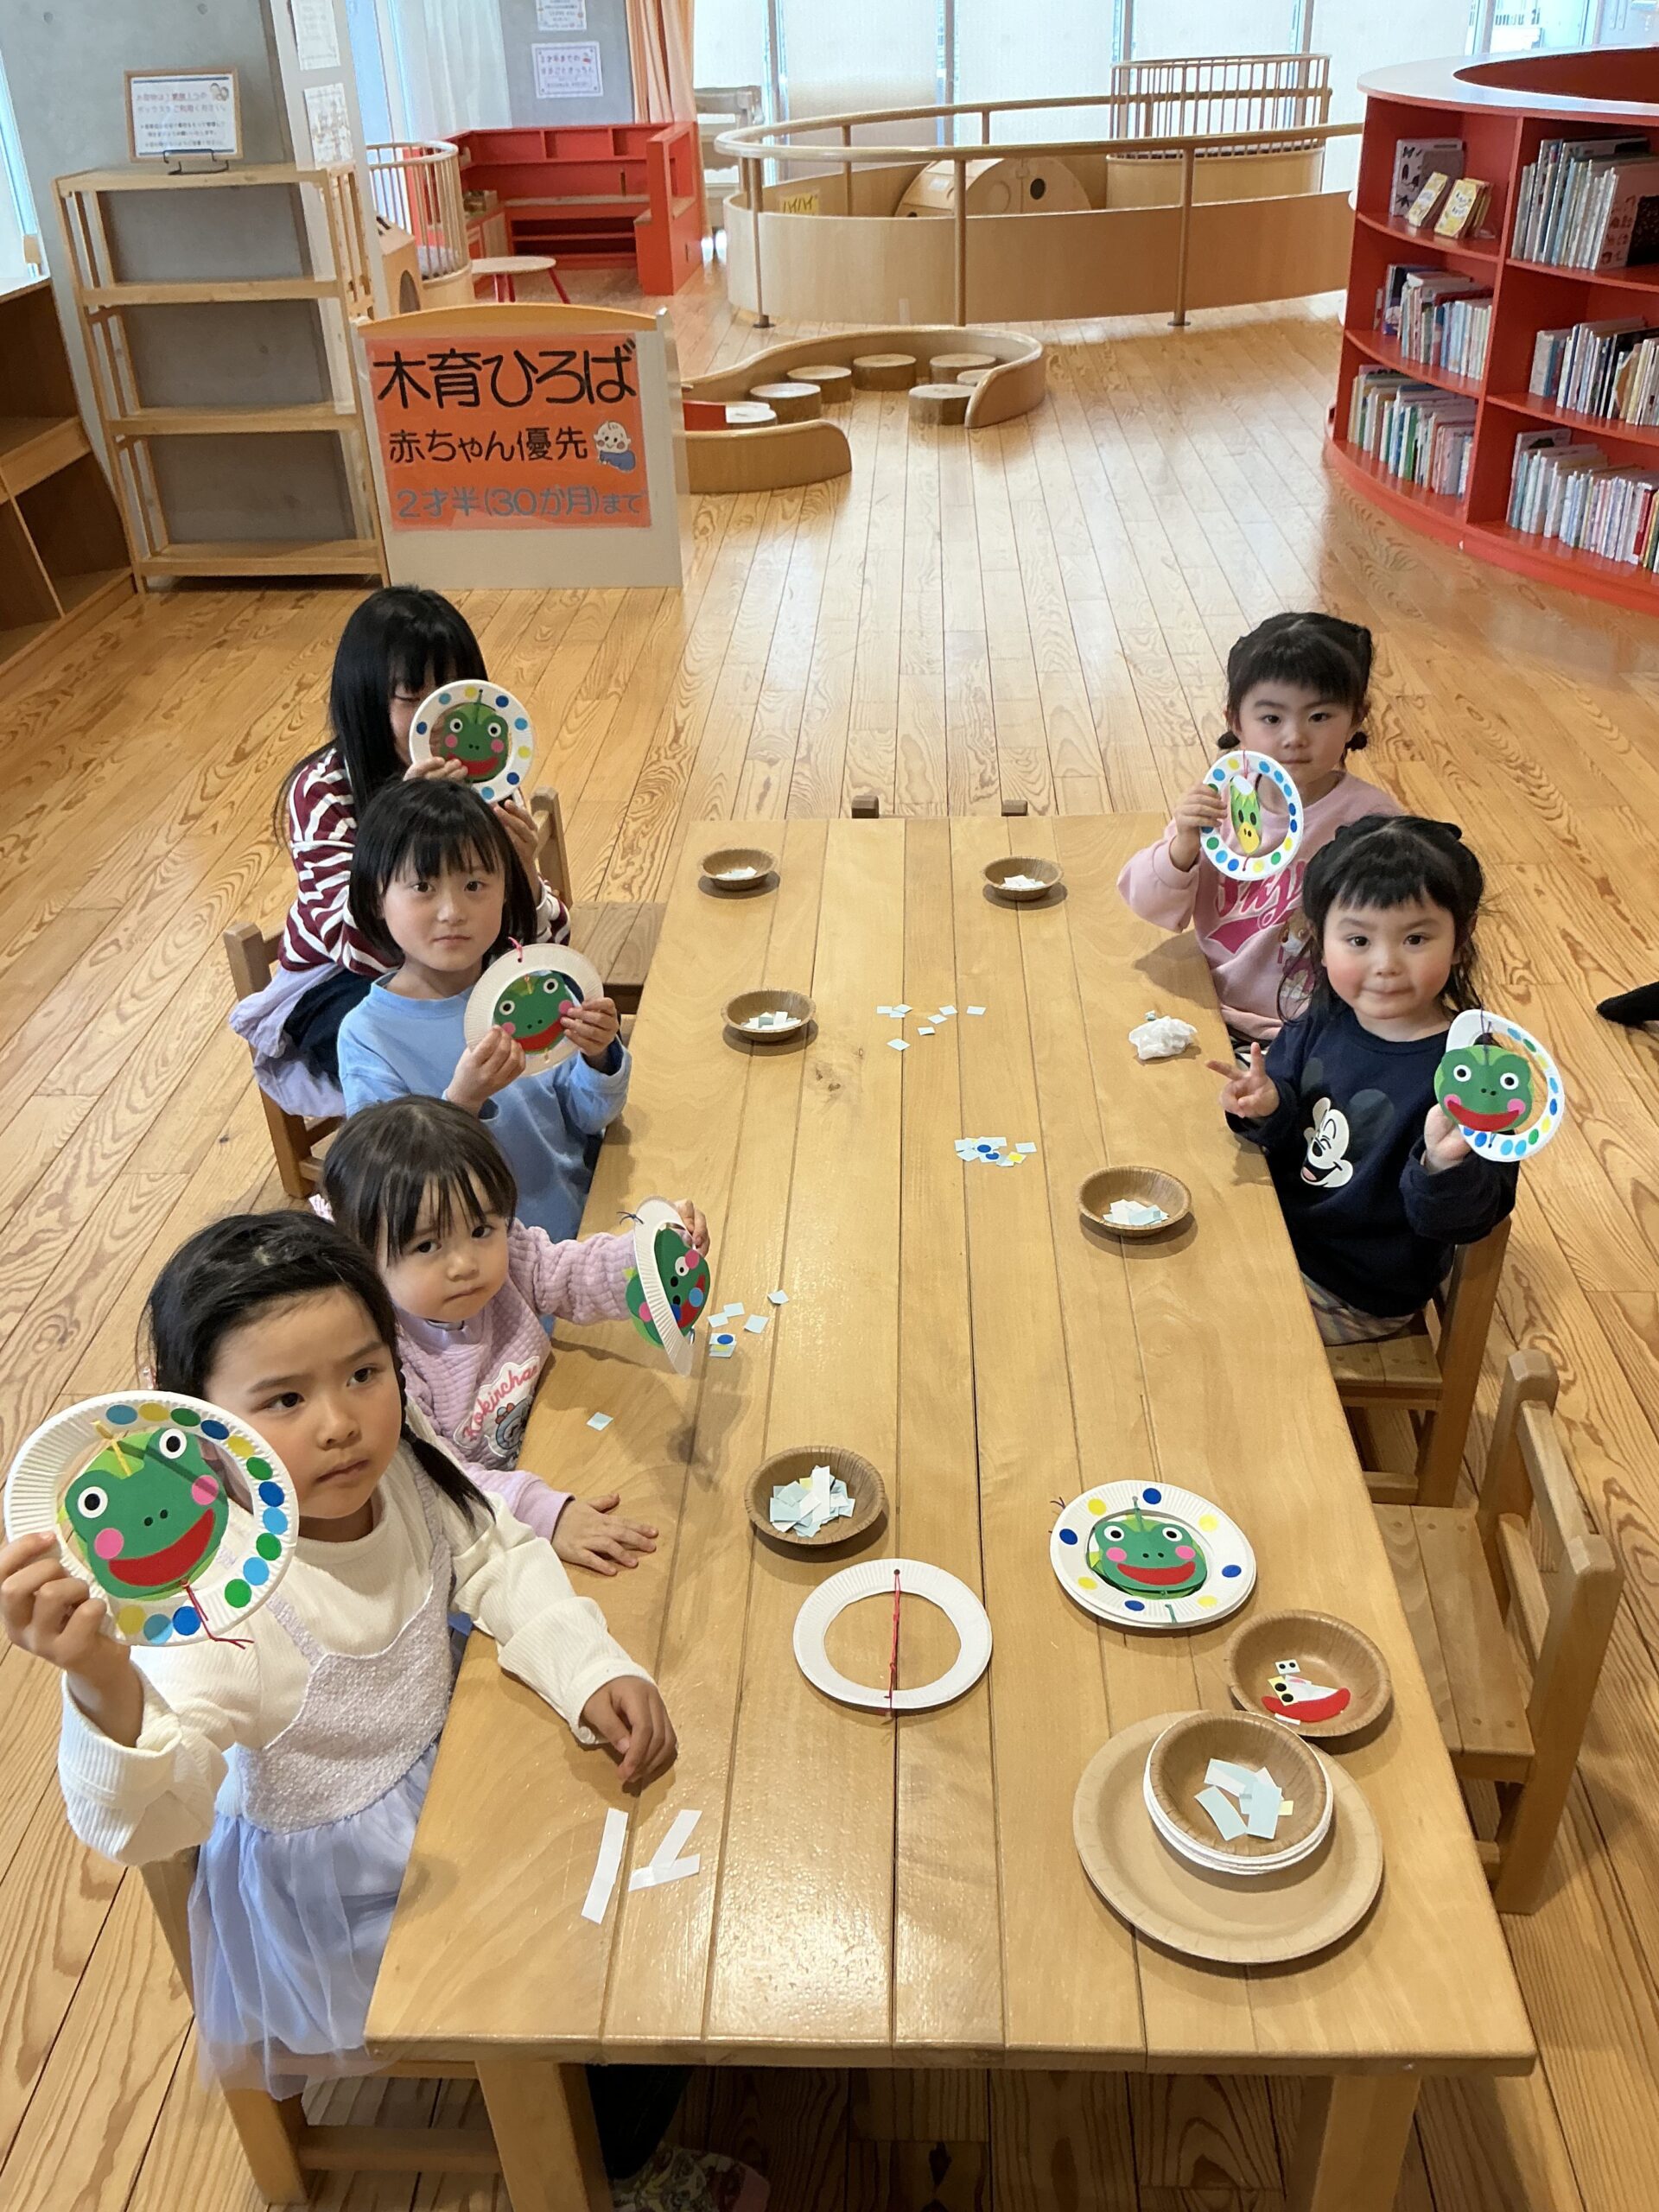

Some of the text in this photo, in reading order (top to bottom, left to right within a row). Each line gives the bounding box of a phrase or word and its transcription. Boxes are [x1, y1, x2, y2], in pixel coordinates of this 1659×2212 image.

[372, 337, 637, 409] 木育ひろば
[389, 426, 588, 463] 赤ちゃん優先
[396, 485, 646, 518] 2才半(30か月)まで
